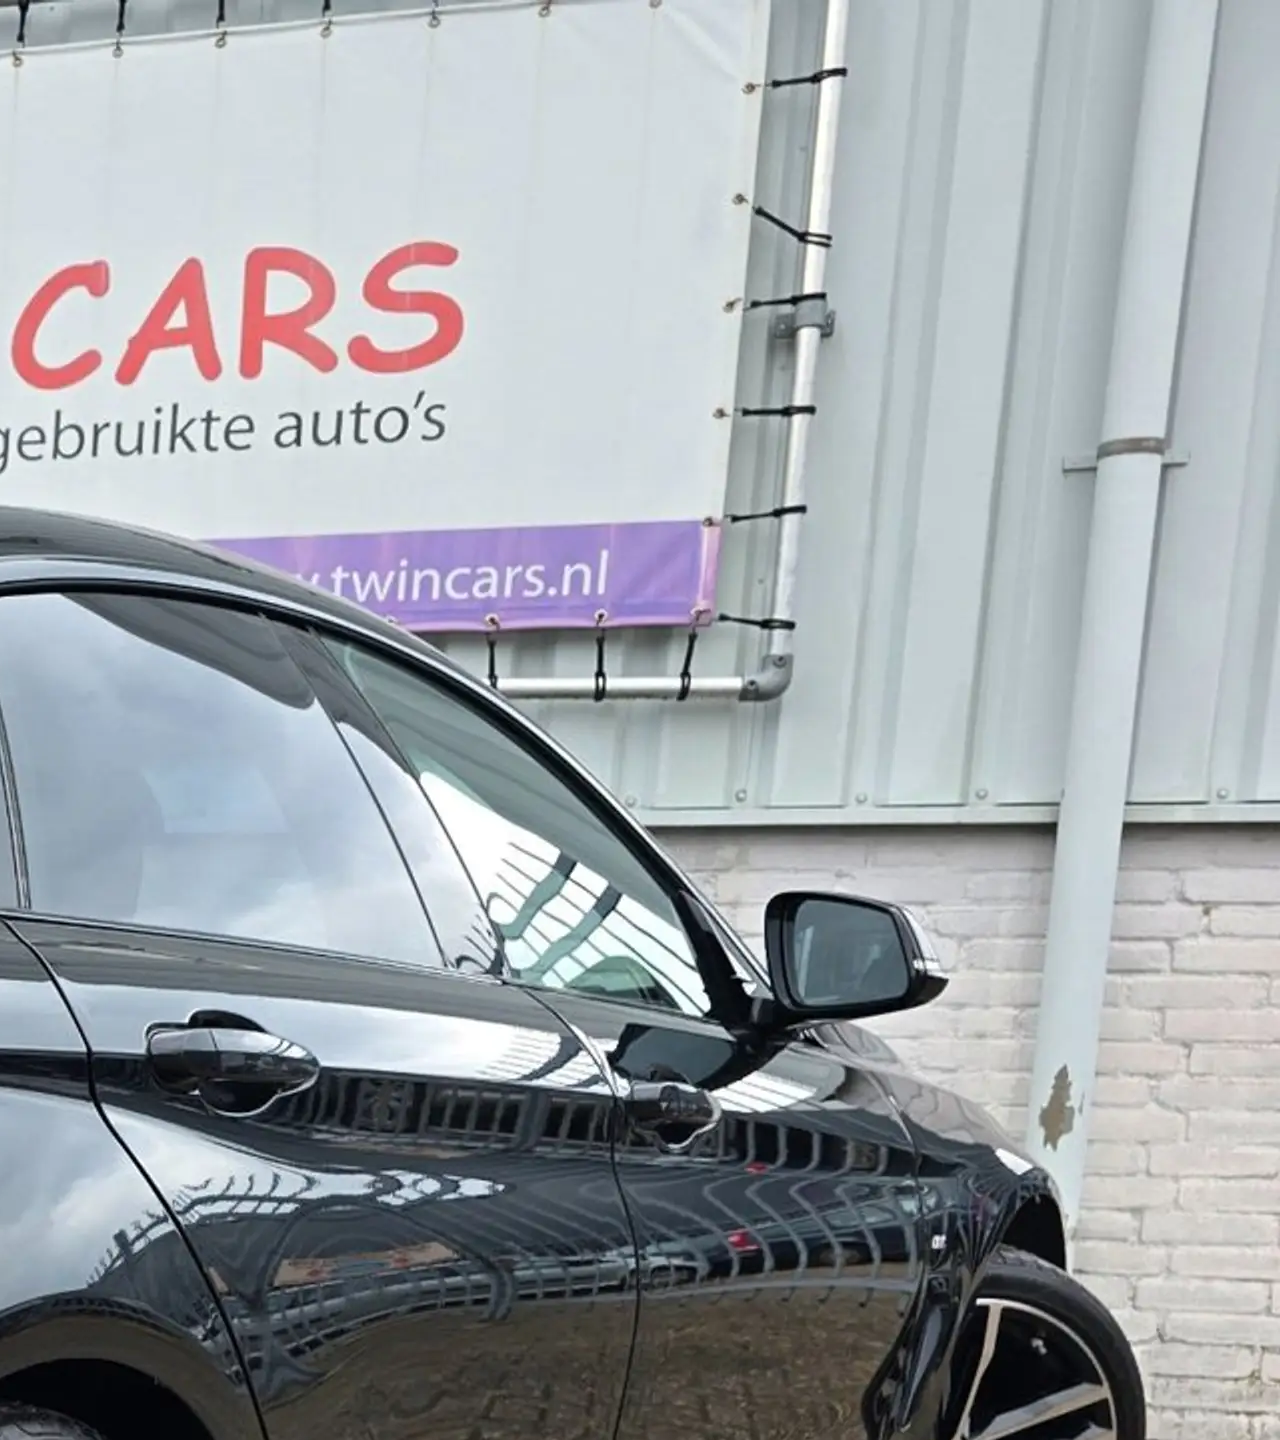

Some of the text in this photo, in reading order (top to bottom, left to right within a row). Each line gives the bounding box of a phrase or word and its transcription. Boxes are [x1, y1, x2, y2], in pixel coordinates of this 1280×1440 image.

[11, 241, 464, 390] CARS
[273, 390, 447, 449] auto's
[293, 549, 609, 604] twincars.nl
